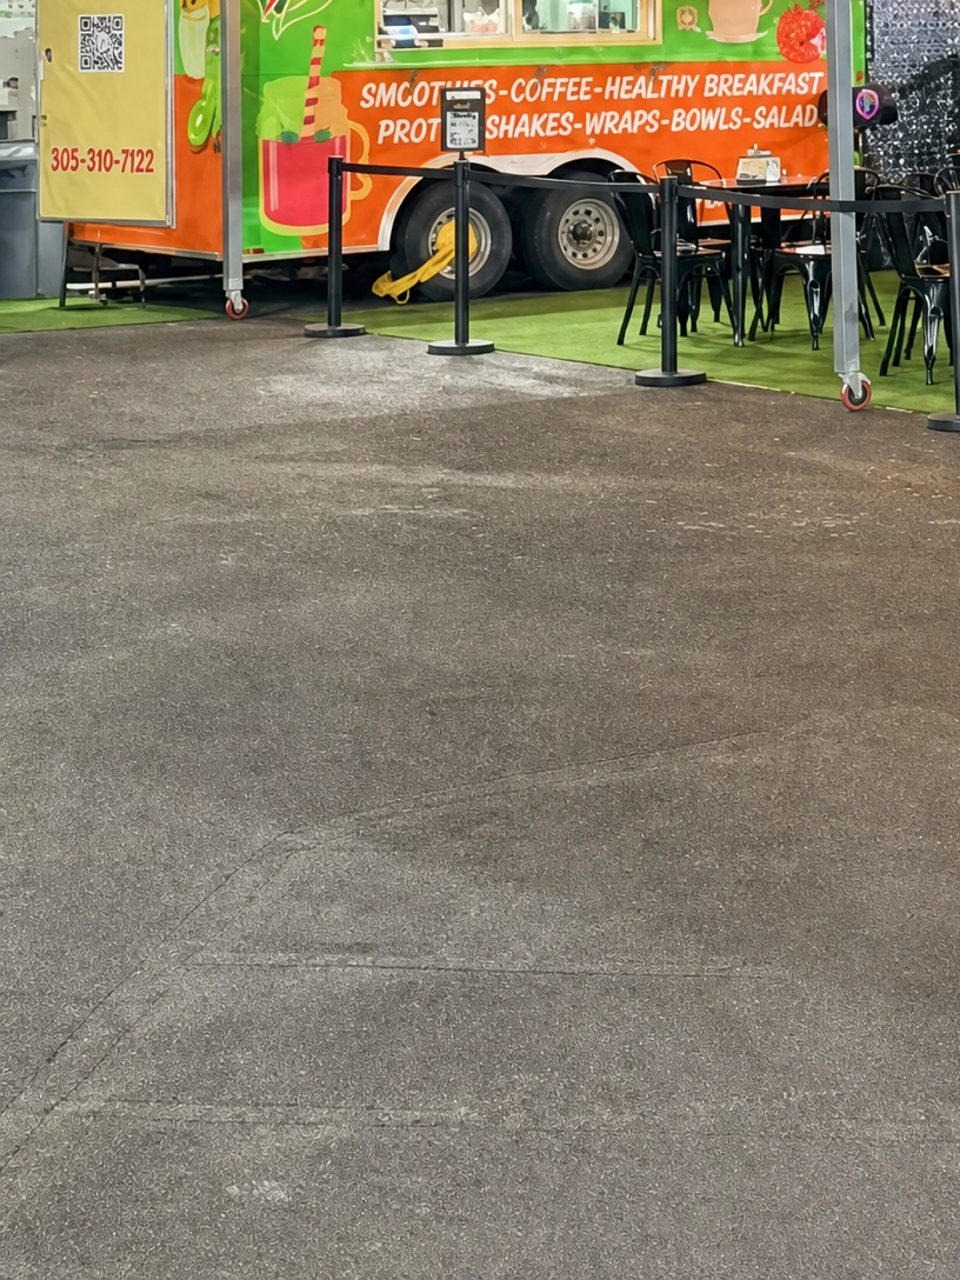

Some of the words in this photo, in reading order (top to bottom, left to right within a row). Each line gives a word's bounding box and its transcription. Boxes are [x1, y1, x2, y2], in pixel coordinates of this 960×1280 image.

[703, 71, 824, 98] BREAKFAST
[377, 117, 442, 144] PROT
[51, 147, 154, 174] 305-310-7122
